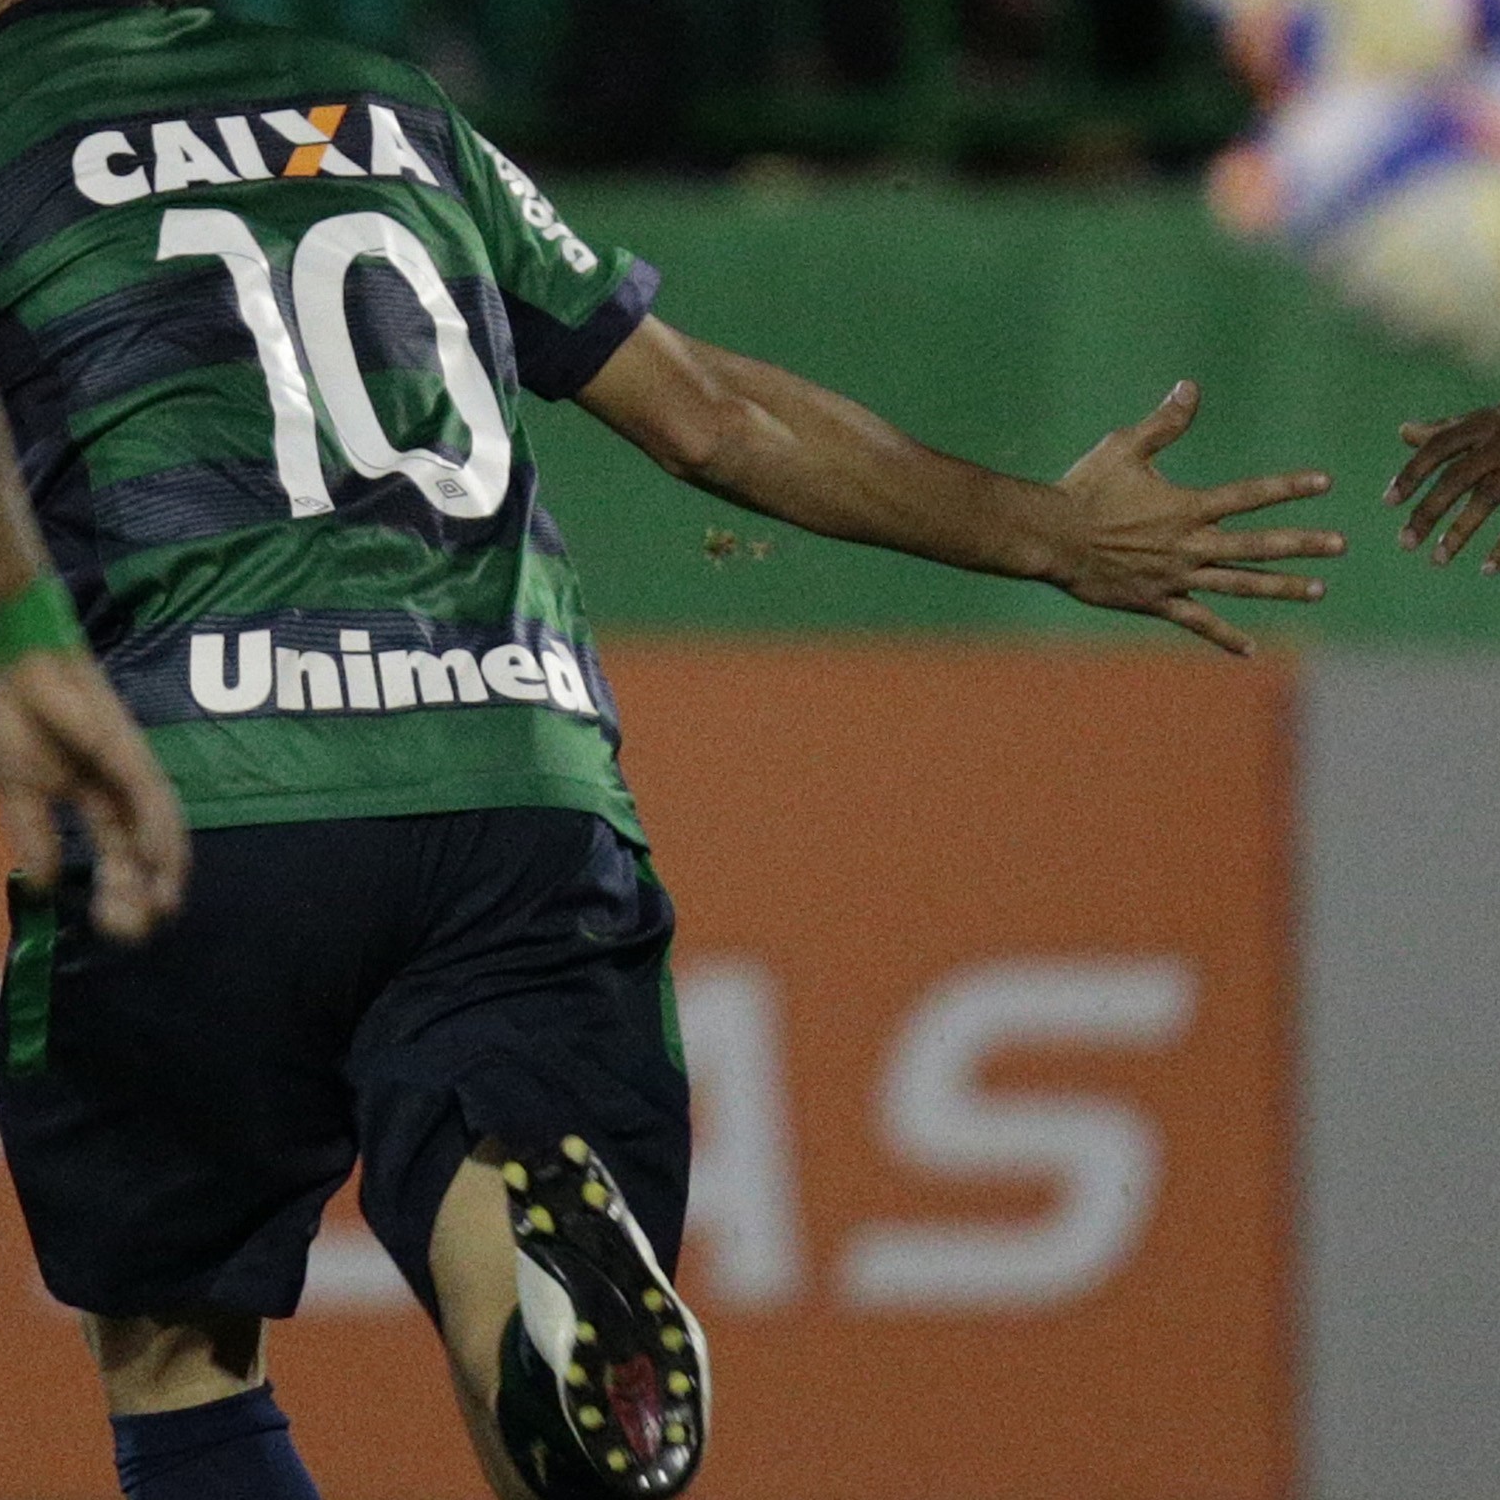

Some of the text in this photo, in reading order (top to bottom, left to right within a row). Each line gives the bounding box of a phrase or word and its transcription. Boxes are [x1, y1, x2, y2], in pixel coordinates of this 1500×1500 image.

[72, 103, 441, 206] CAIXA
[156, 207, 511, 519] 10
[189, 629, 600, 715] Unimed
